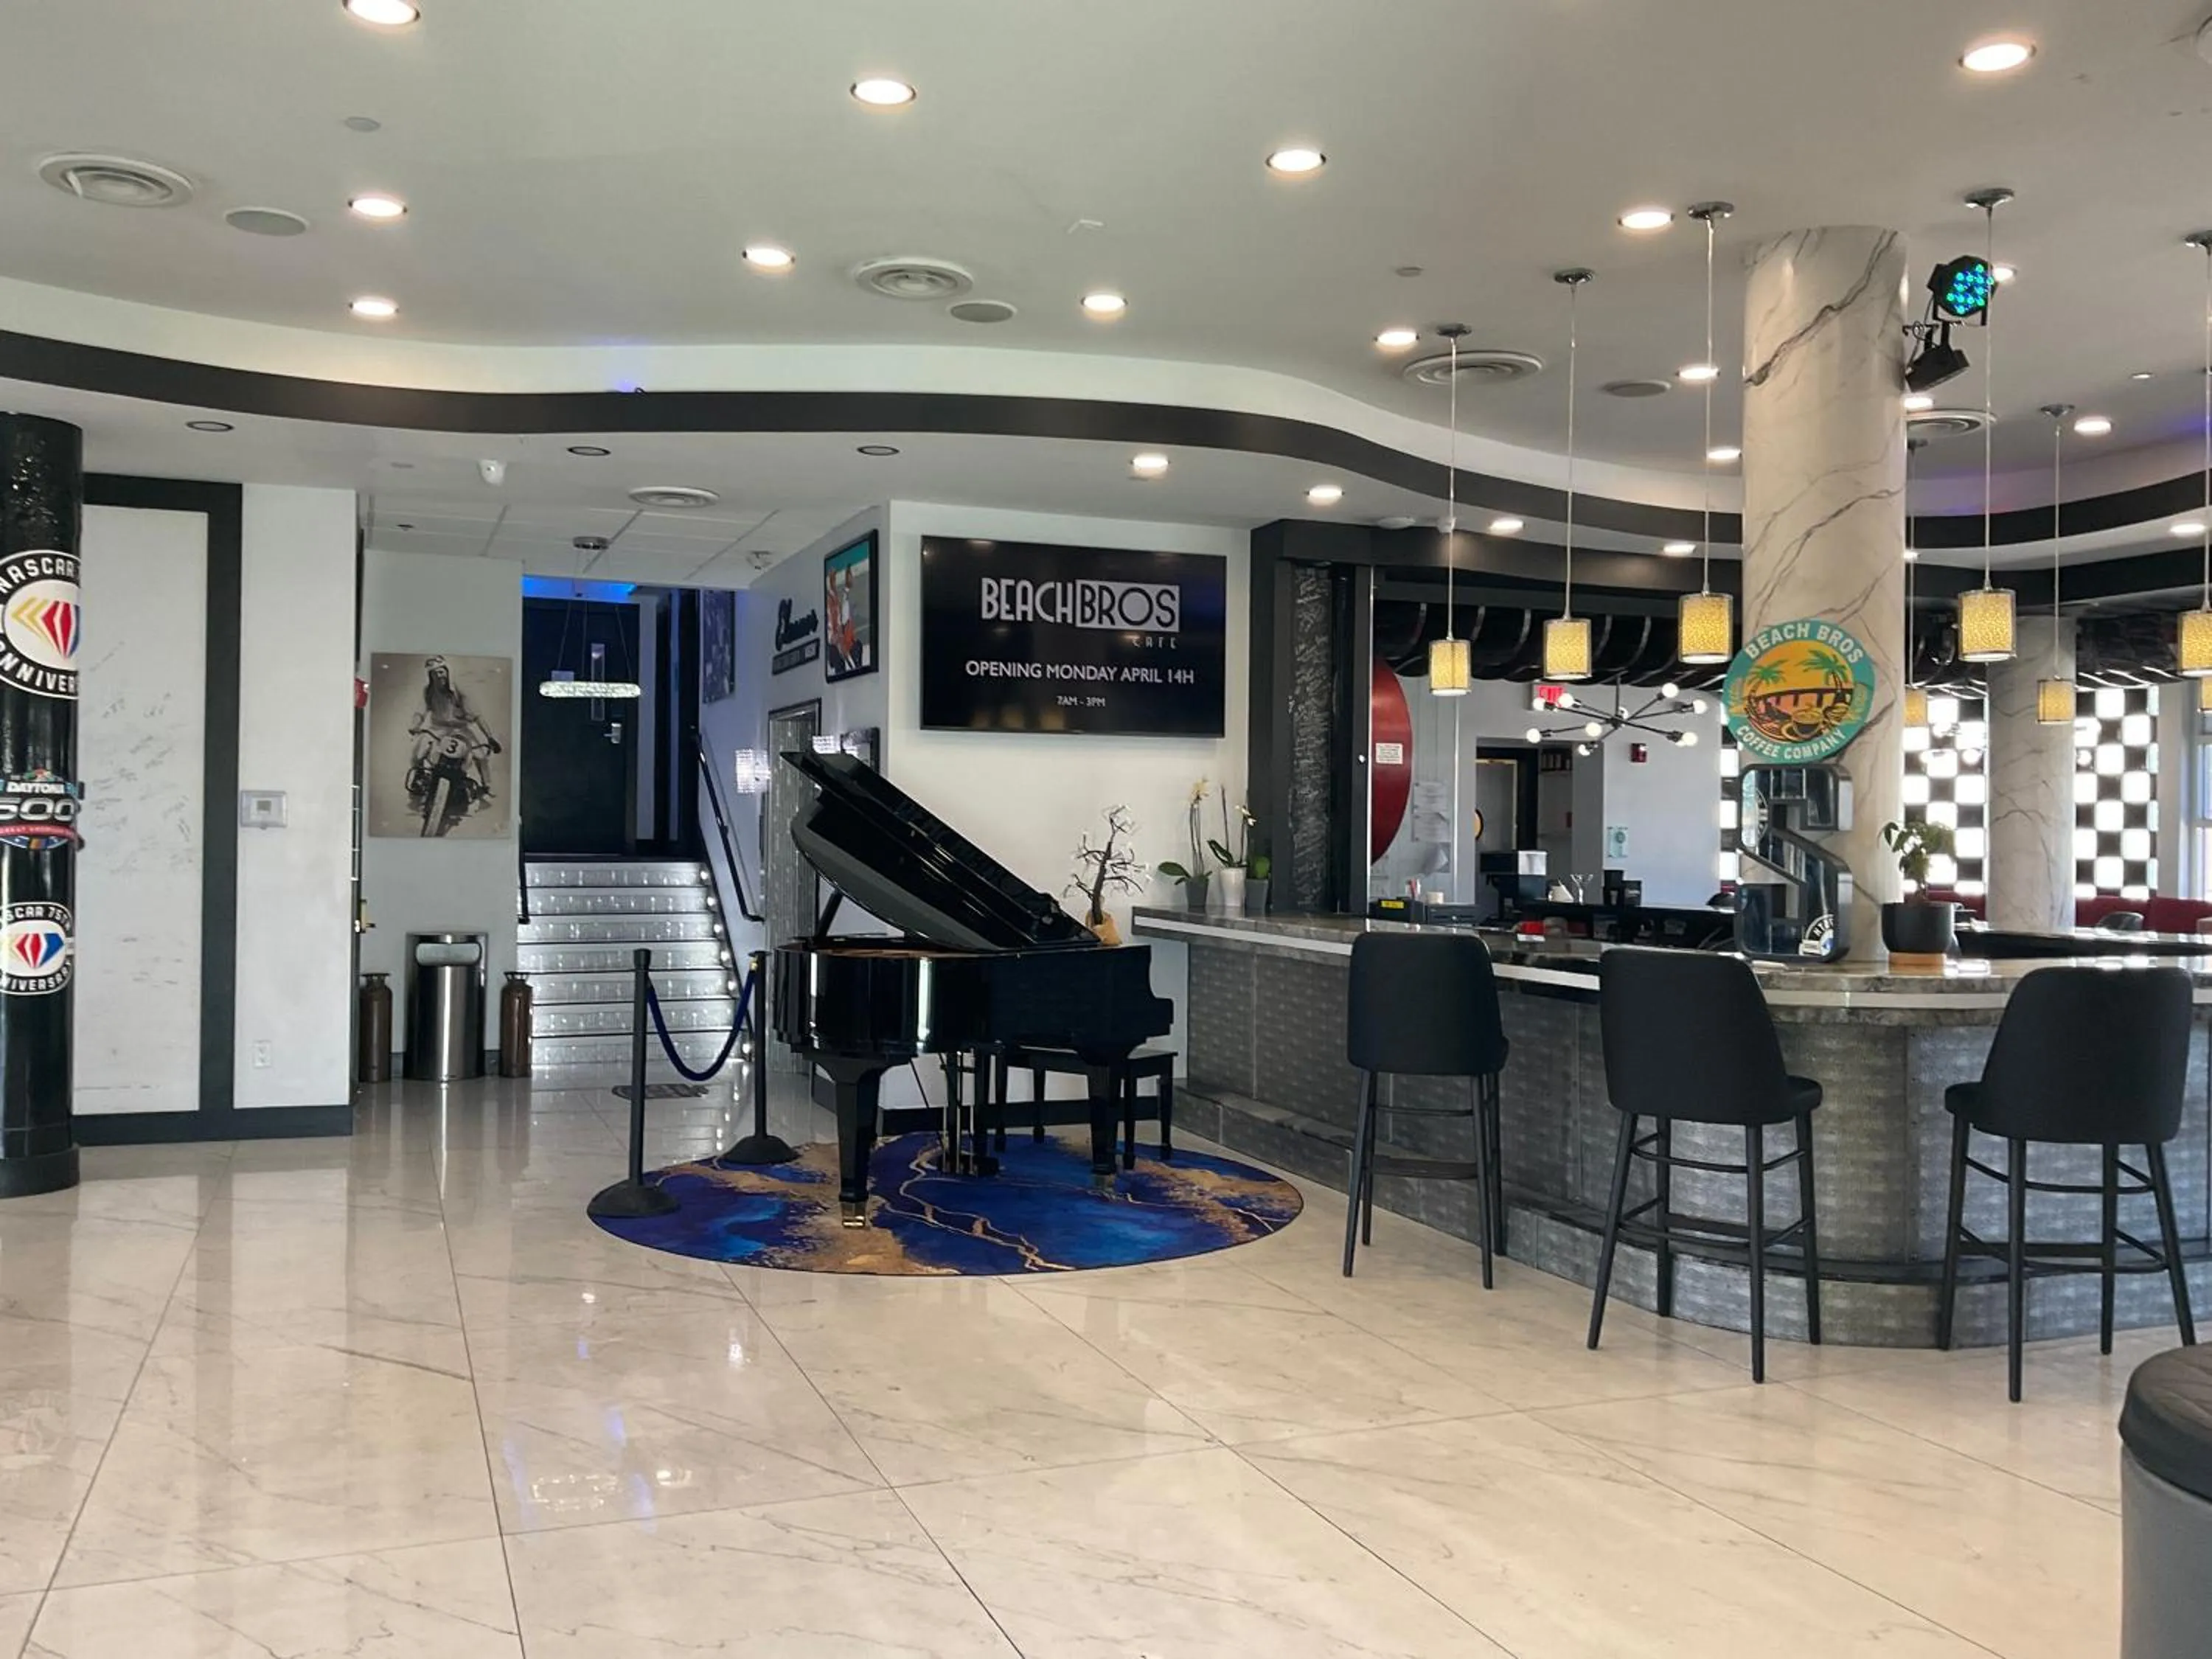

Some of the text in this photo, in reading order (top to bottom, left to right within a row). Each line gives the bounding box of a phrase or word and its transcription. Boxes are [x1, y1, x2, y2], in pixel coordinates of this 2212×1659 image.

[981, 577, 1176, 628] BEACH BROS
[1745, 622, 1863, 664] BEACH BROS
[965, 661, 1194, 685] OPENING MONDAY APRIL 14H
[1056, 696, 1078, 707] 7AM
[1086, 698, 1106, 708] 3PM
[446, 740, 459, 754] 3
[1736, 725, 1846, 759] COFFEE COMPANY
